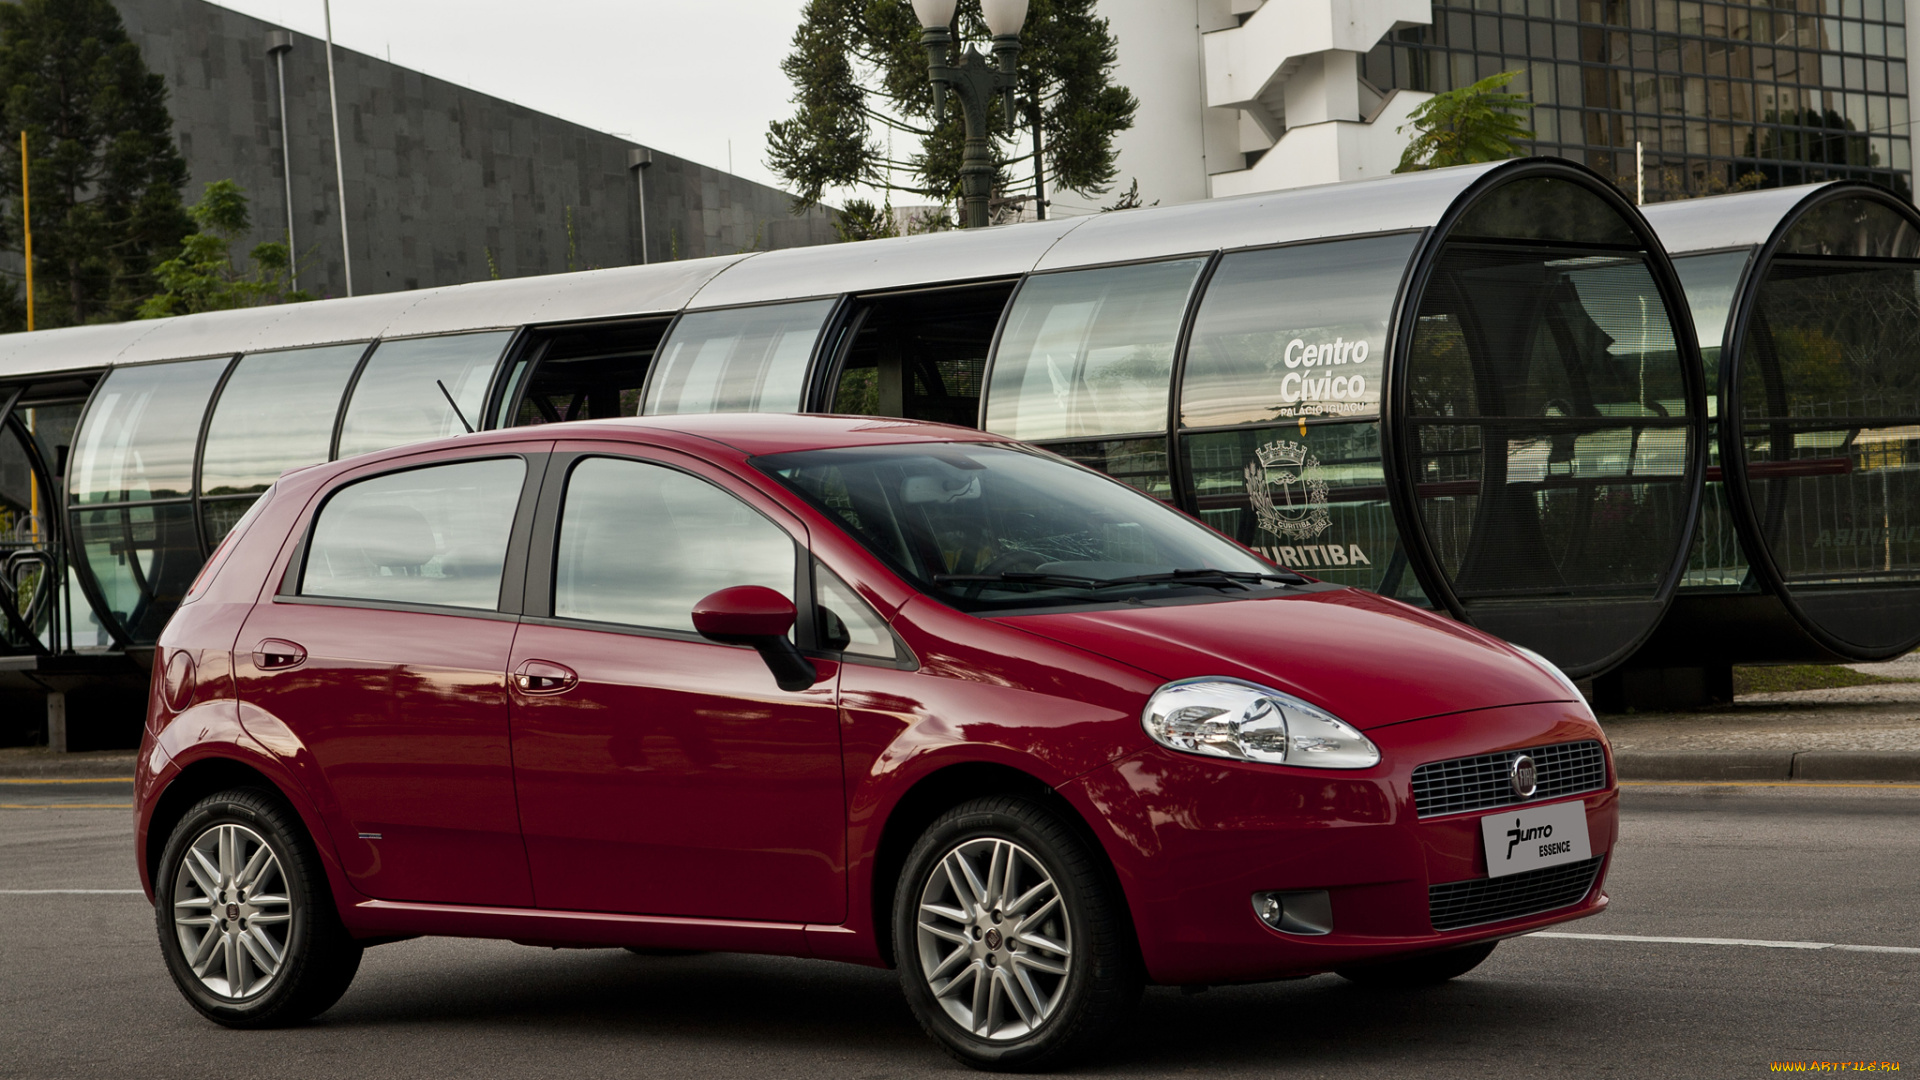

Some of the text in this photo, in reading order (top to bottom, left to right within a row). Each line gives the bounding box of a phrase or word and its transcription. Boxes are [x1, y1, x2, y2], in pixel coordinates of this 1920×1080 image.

[1284, 337, 1369, 369] Centro
[1281, 370, 1366, 403] Cívico
[1325, 402, 1365, 414] IGUAÇU
[1277, 520, 1312, 529] CURITIBA
[1250, 544, 1371, 567] URITIBA
[1538, 840, 1571, 857] ESSENCE
